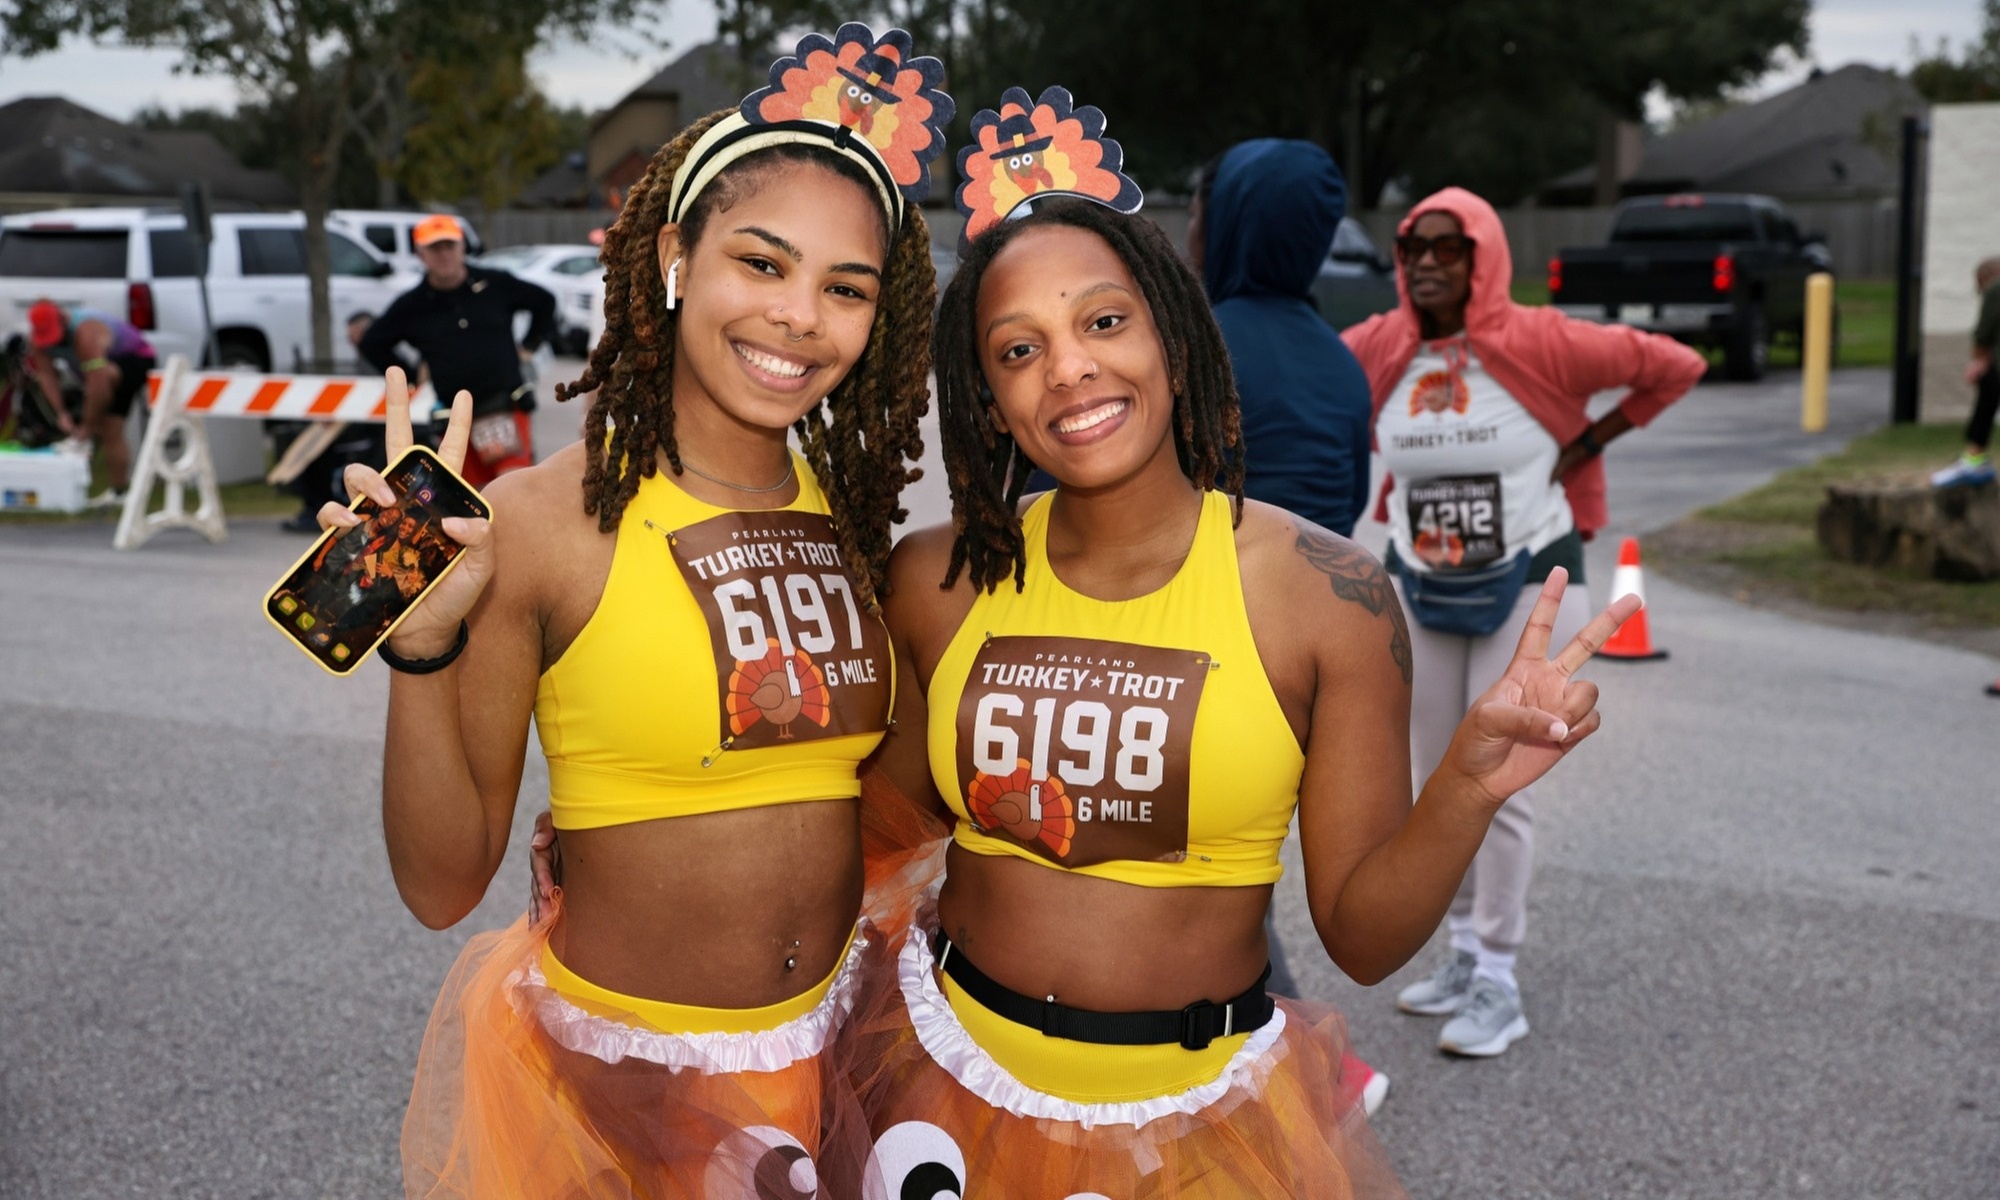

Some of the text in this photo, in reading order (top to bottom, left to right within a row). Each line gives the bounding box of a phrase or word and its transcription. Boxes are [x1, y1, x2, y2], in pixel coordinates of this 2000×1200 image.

[732, 529, 805, 540] PEARLAND
[1418, 500, 1493, 538] 4212
[688, 542, 842, 580] TURKEY TROT
[712, 574, 863, 662] 6197
[825, 659, 877, 687] 6 MILE
[1035, 653, 1135, 669] PEARLAND
[982, 663, 1185, 702] TURKEY TROT
[973, 692, 1170, 792] 6198
[1077, 796, 1153, 823] 6 MILE
